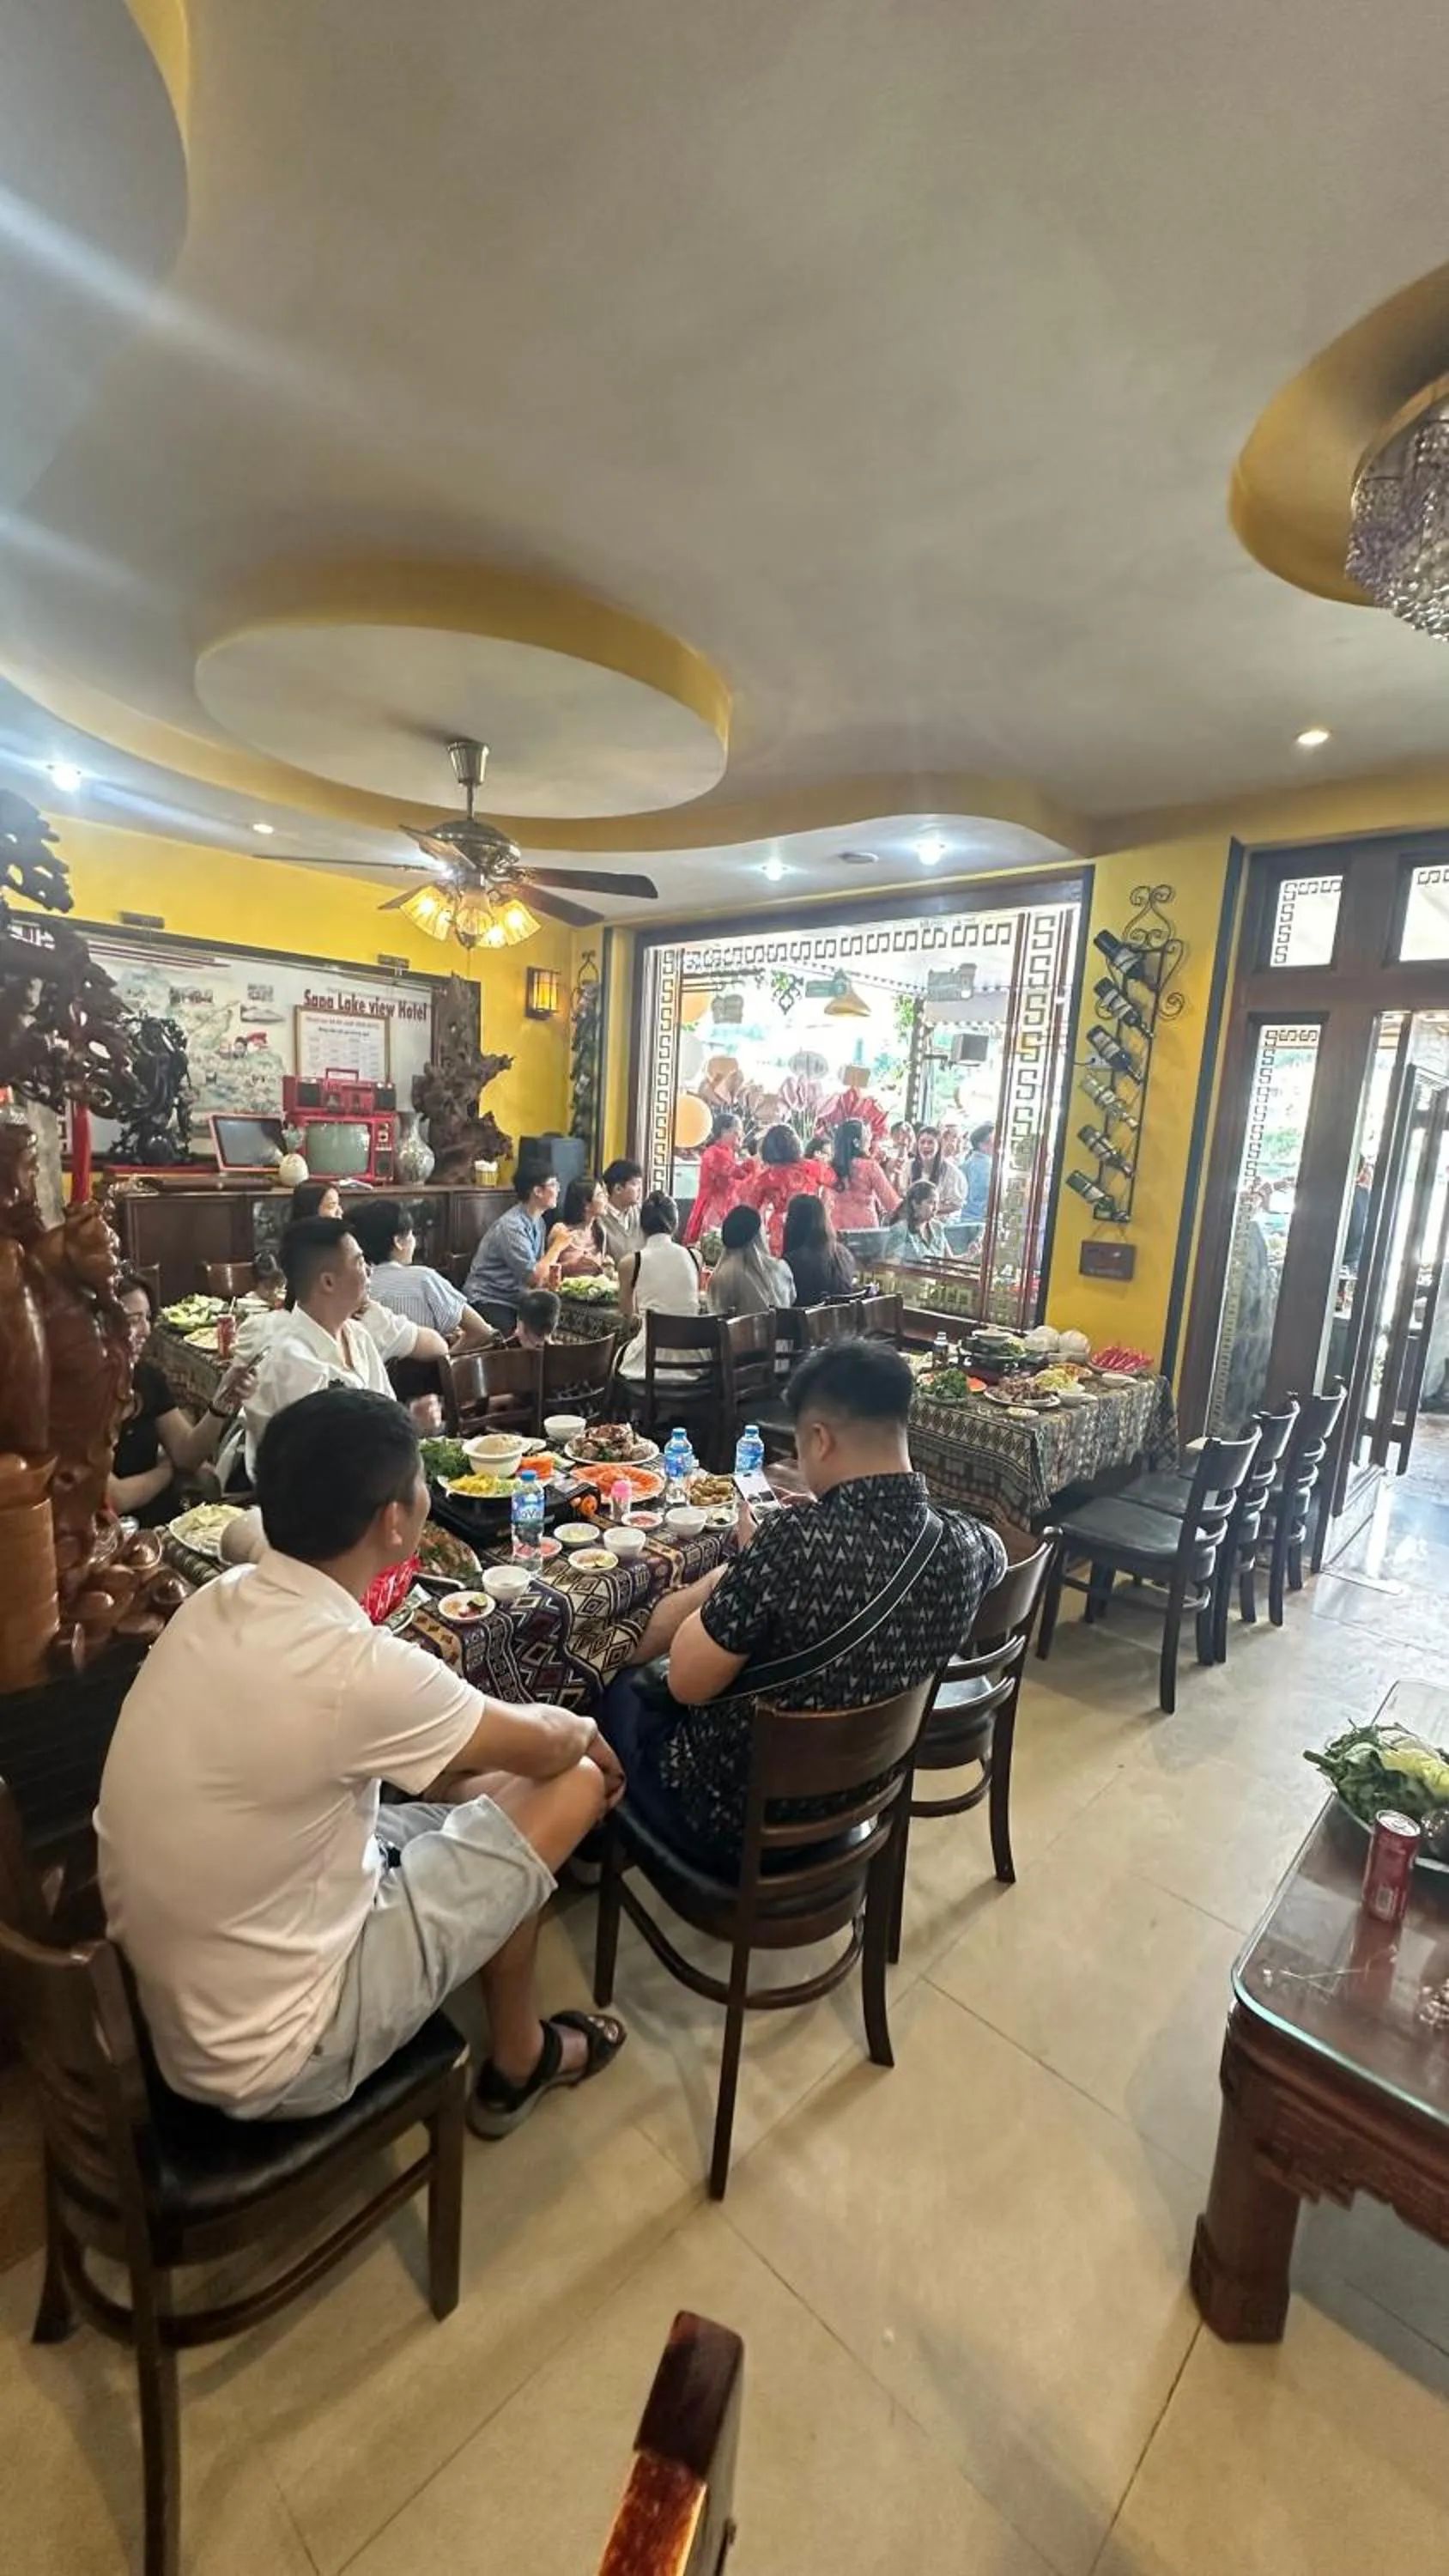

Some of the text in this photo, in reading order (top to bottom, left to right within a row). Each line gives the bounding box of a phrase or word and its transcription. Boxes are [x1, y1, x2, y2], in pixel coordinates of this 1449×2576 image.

[304, 988, 427, 1021] Sapa Lake view Hotel
